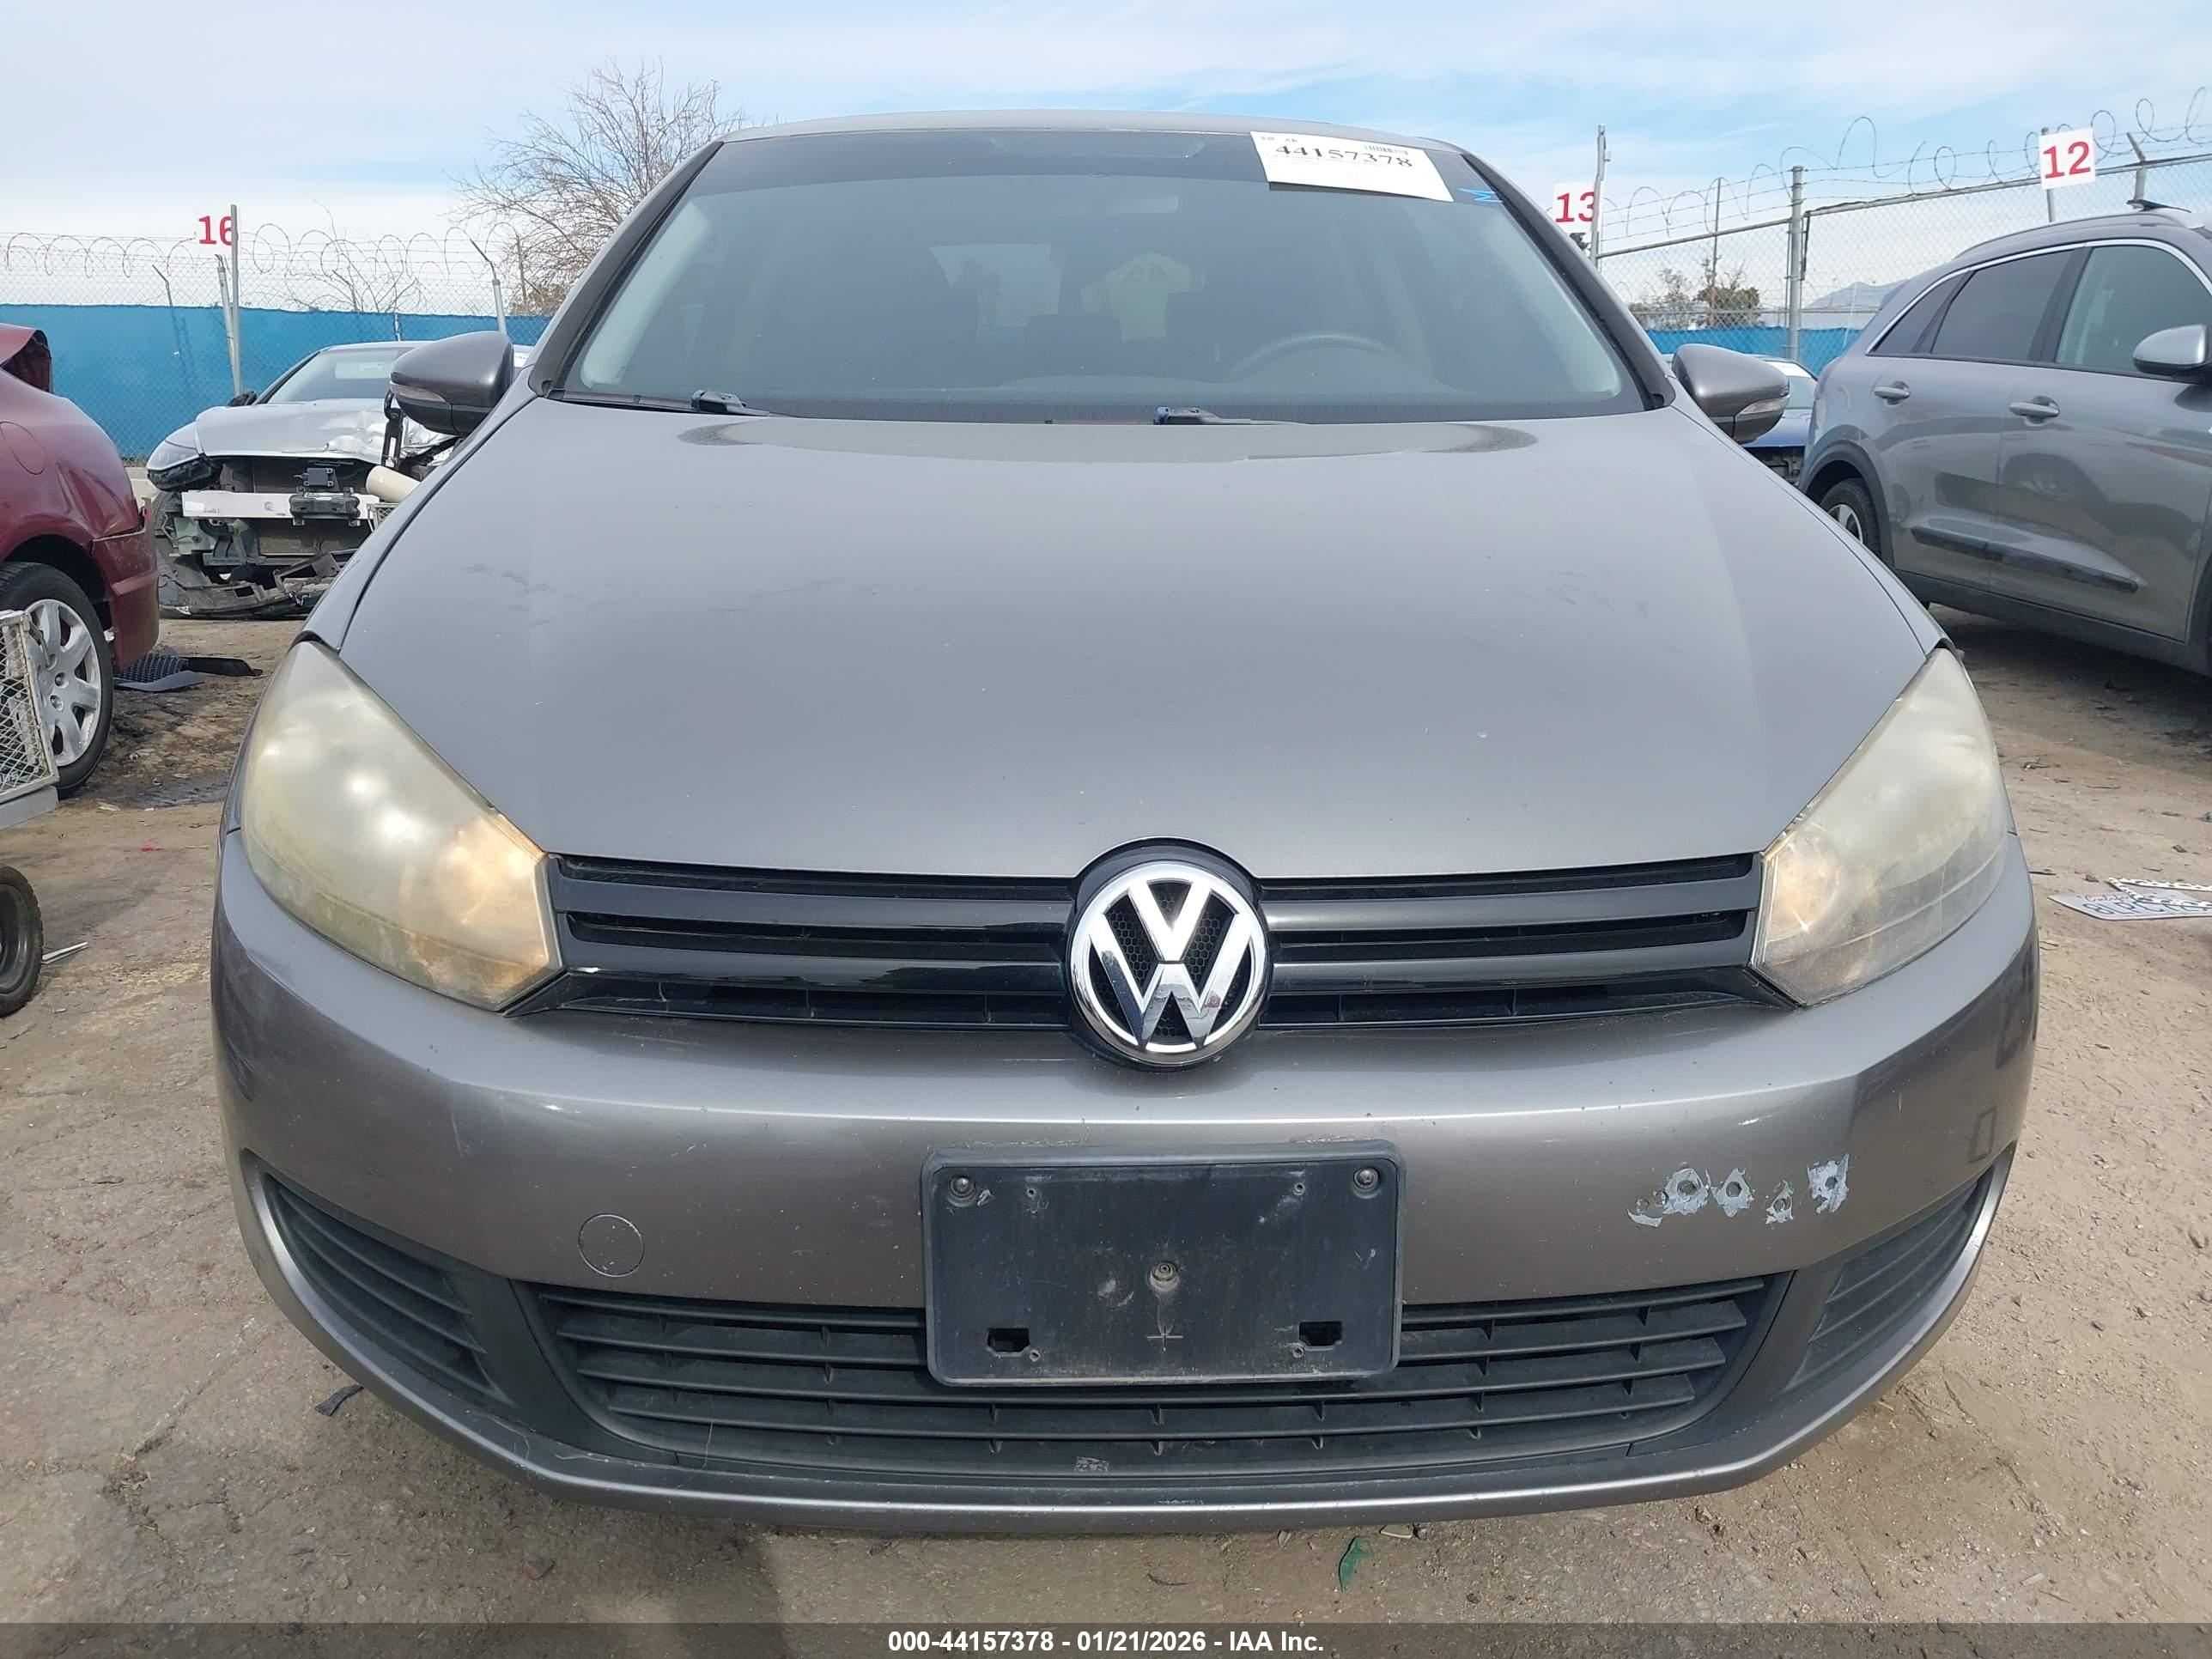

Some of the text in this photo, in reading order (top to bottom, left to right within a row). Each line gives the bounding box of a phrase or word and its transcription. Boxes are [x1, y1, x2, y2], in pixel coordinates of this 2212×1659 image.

[1276, 145, 1413, 167] 44157378
[2044, 142, 2091, 179] 12
[1555, 191, 1595, 222] 13
[198, 215, 232, 246] 16
